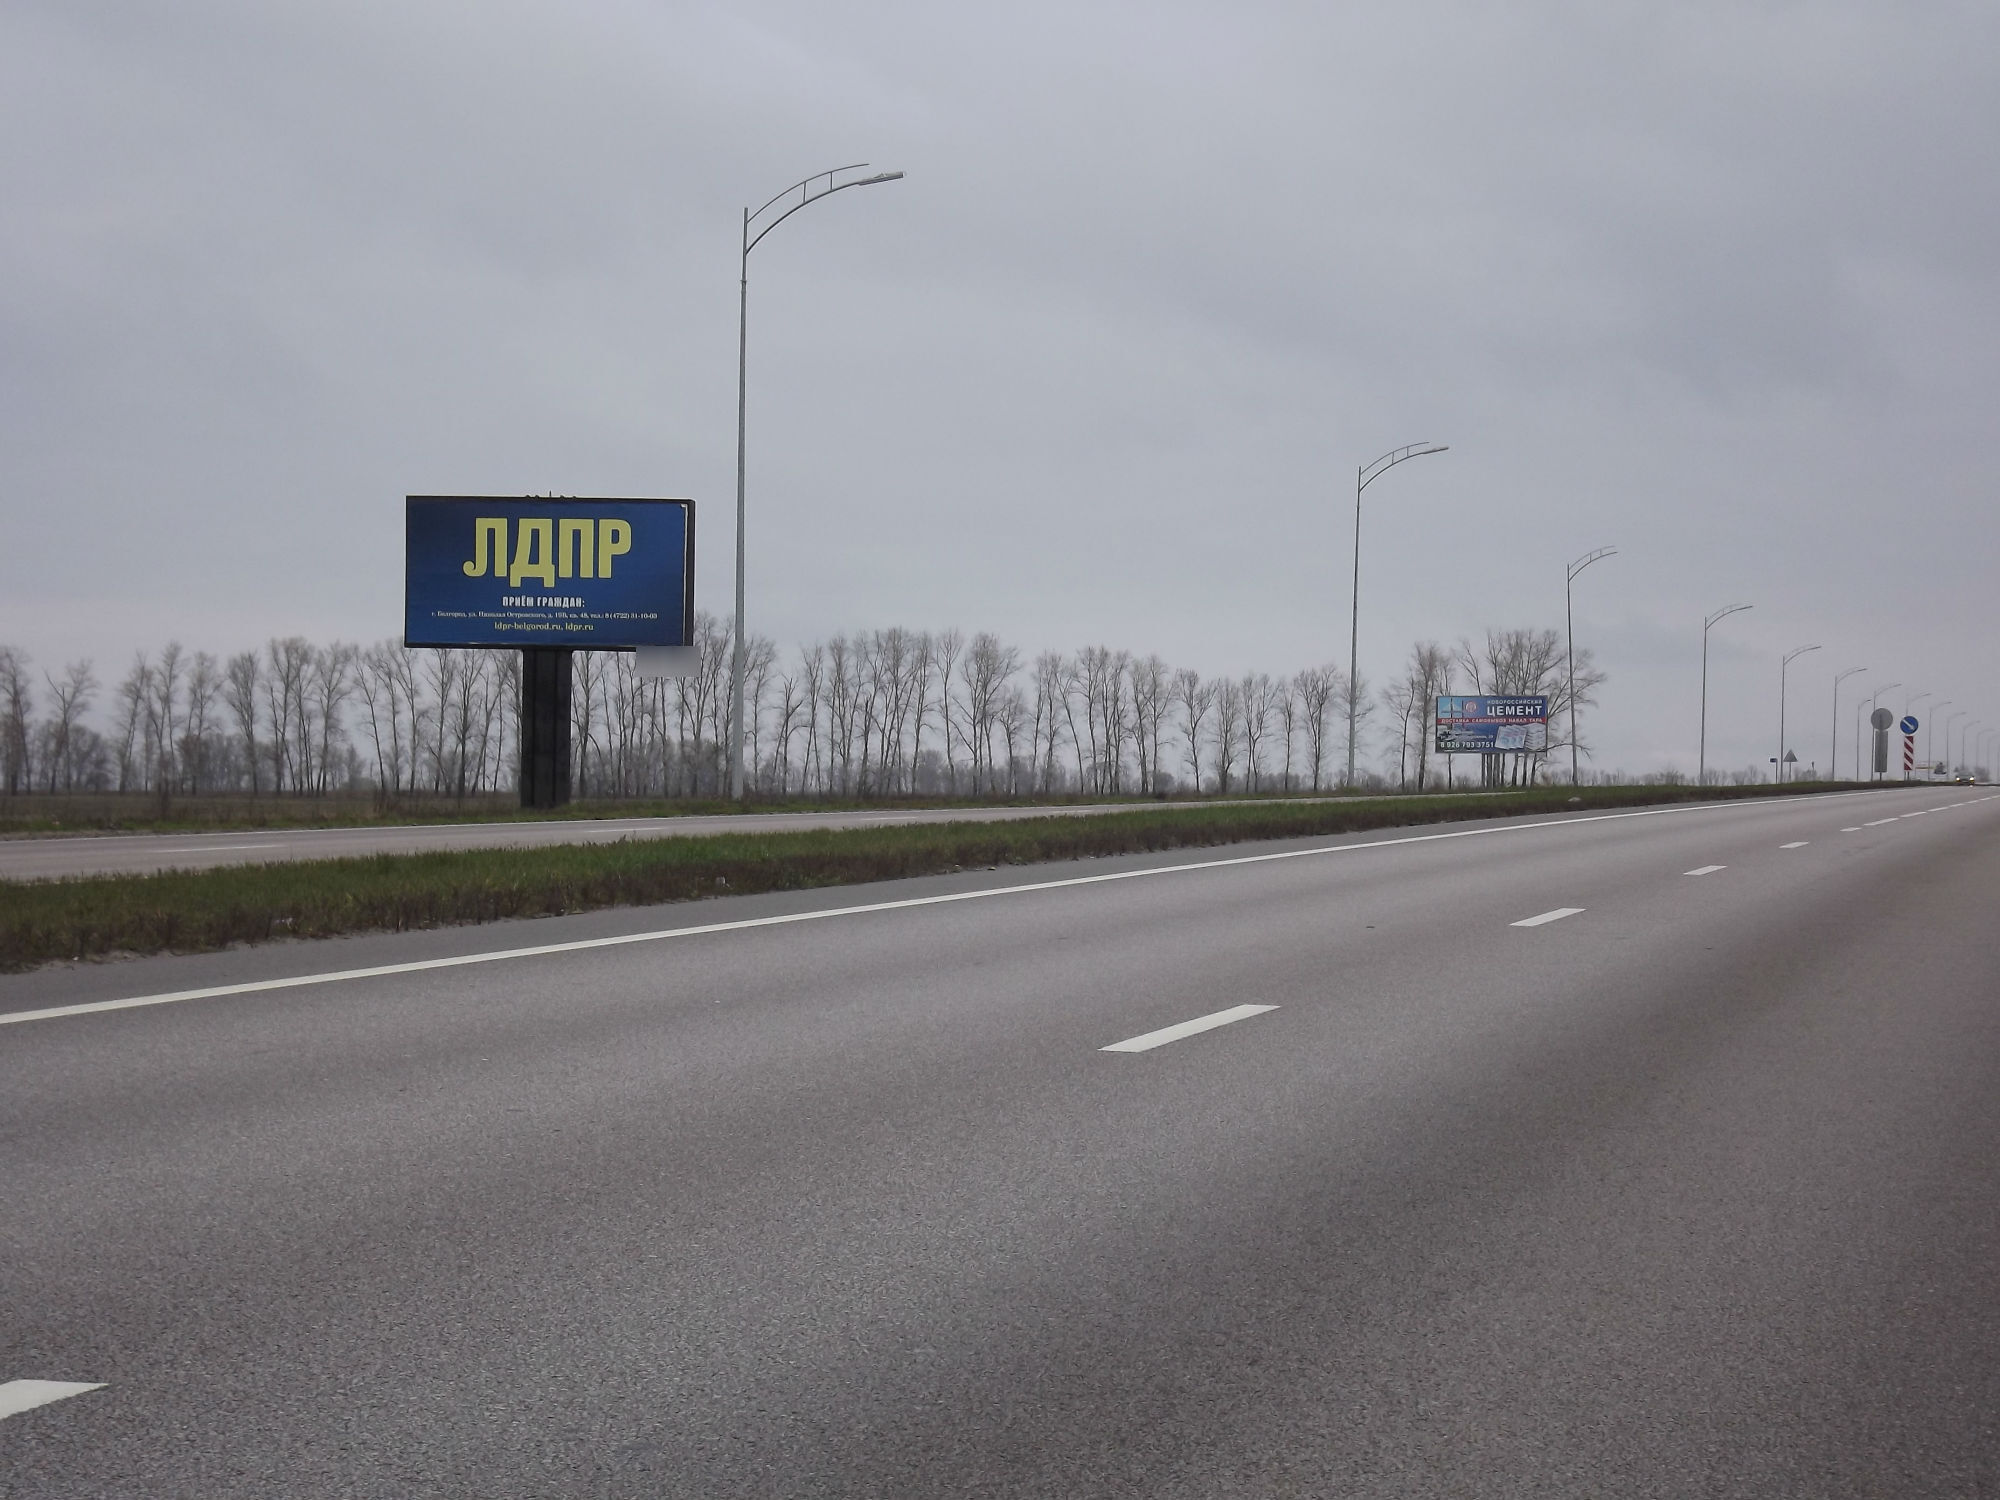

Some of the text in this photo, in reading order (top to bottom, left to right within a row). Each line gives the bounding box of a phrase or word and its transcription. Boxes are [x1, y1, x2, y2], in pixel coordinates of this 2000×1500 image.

[462, 517, 632, 588] ЛДПР
[502, 595, 585, 608] ПРИЁМ ГРАЖДАН:
[494, 621, 594, 631] ldpr-belgorod.ru, ldpr.ru
[1487, 706, 1542, 717] ЦЕМЕНТ
